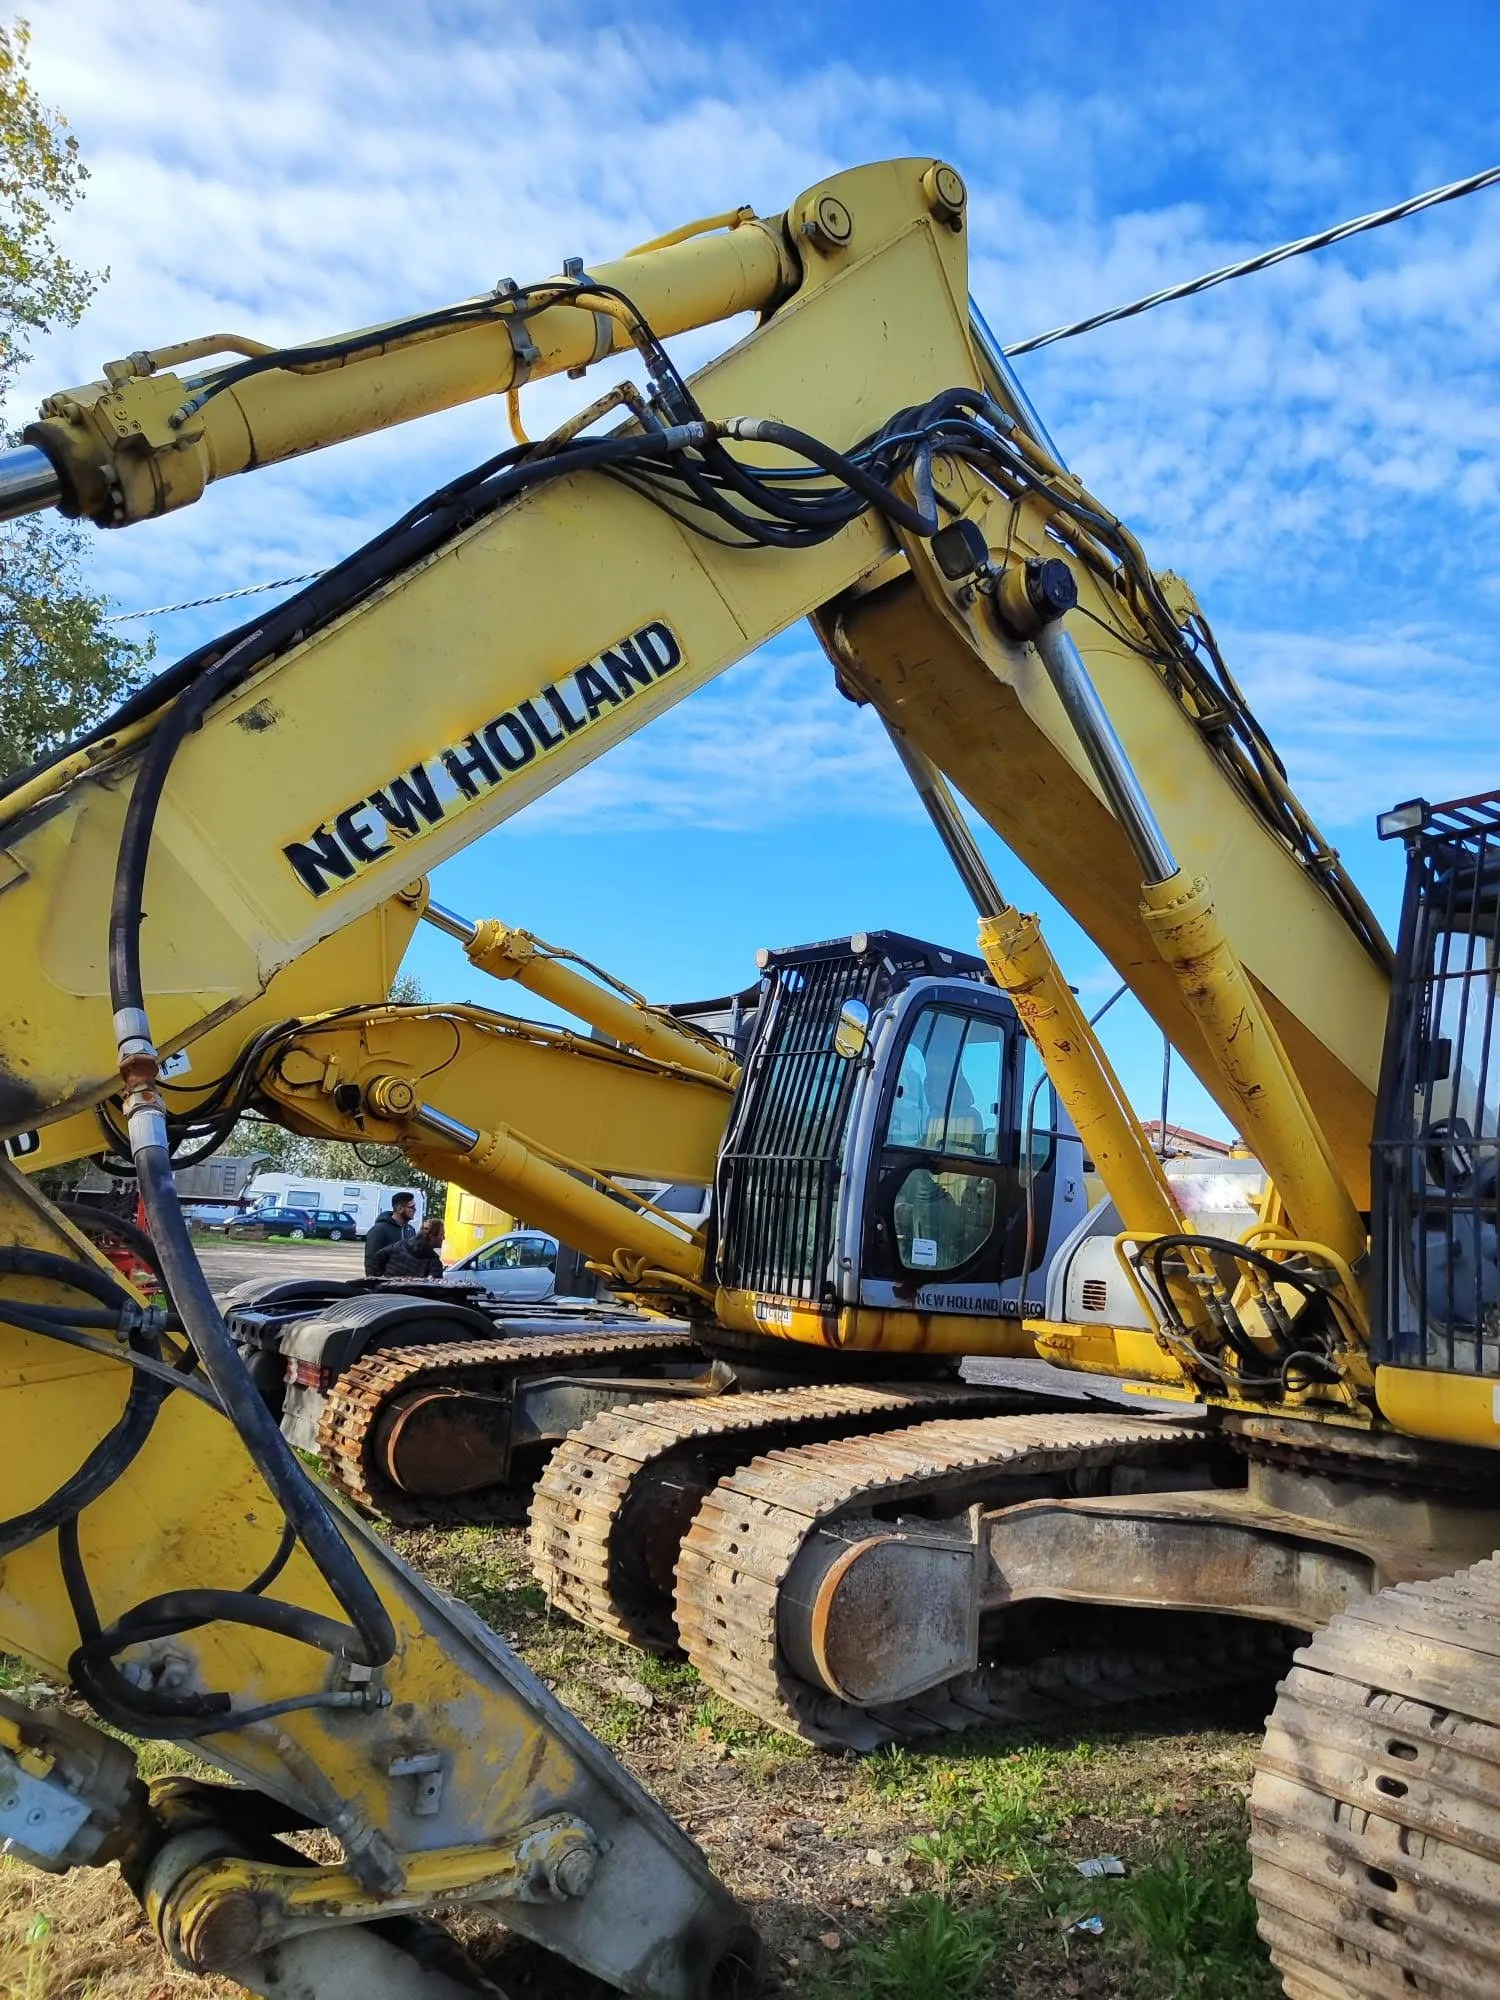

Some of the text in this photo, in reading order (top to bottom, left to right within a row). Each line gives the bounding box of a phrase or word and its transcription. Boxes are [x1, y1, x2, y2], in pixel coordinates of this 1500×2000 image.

[282, 619, 682, 897] NEW HOLLAND
[917, 1293, 945, 1306] NEW
[947, 1295, 999, 1313] HOLLAND
